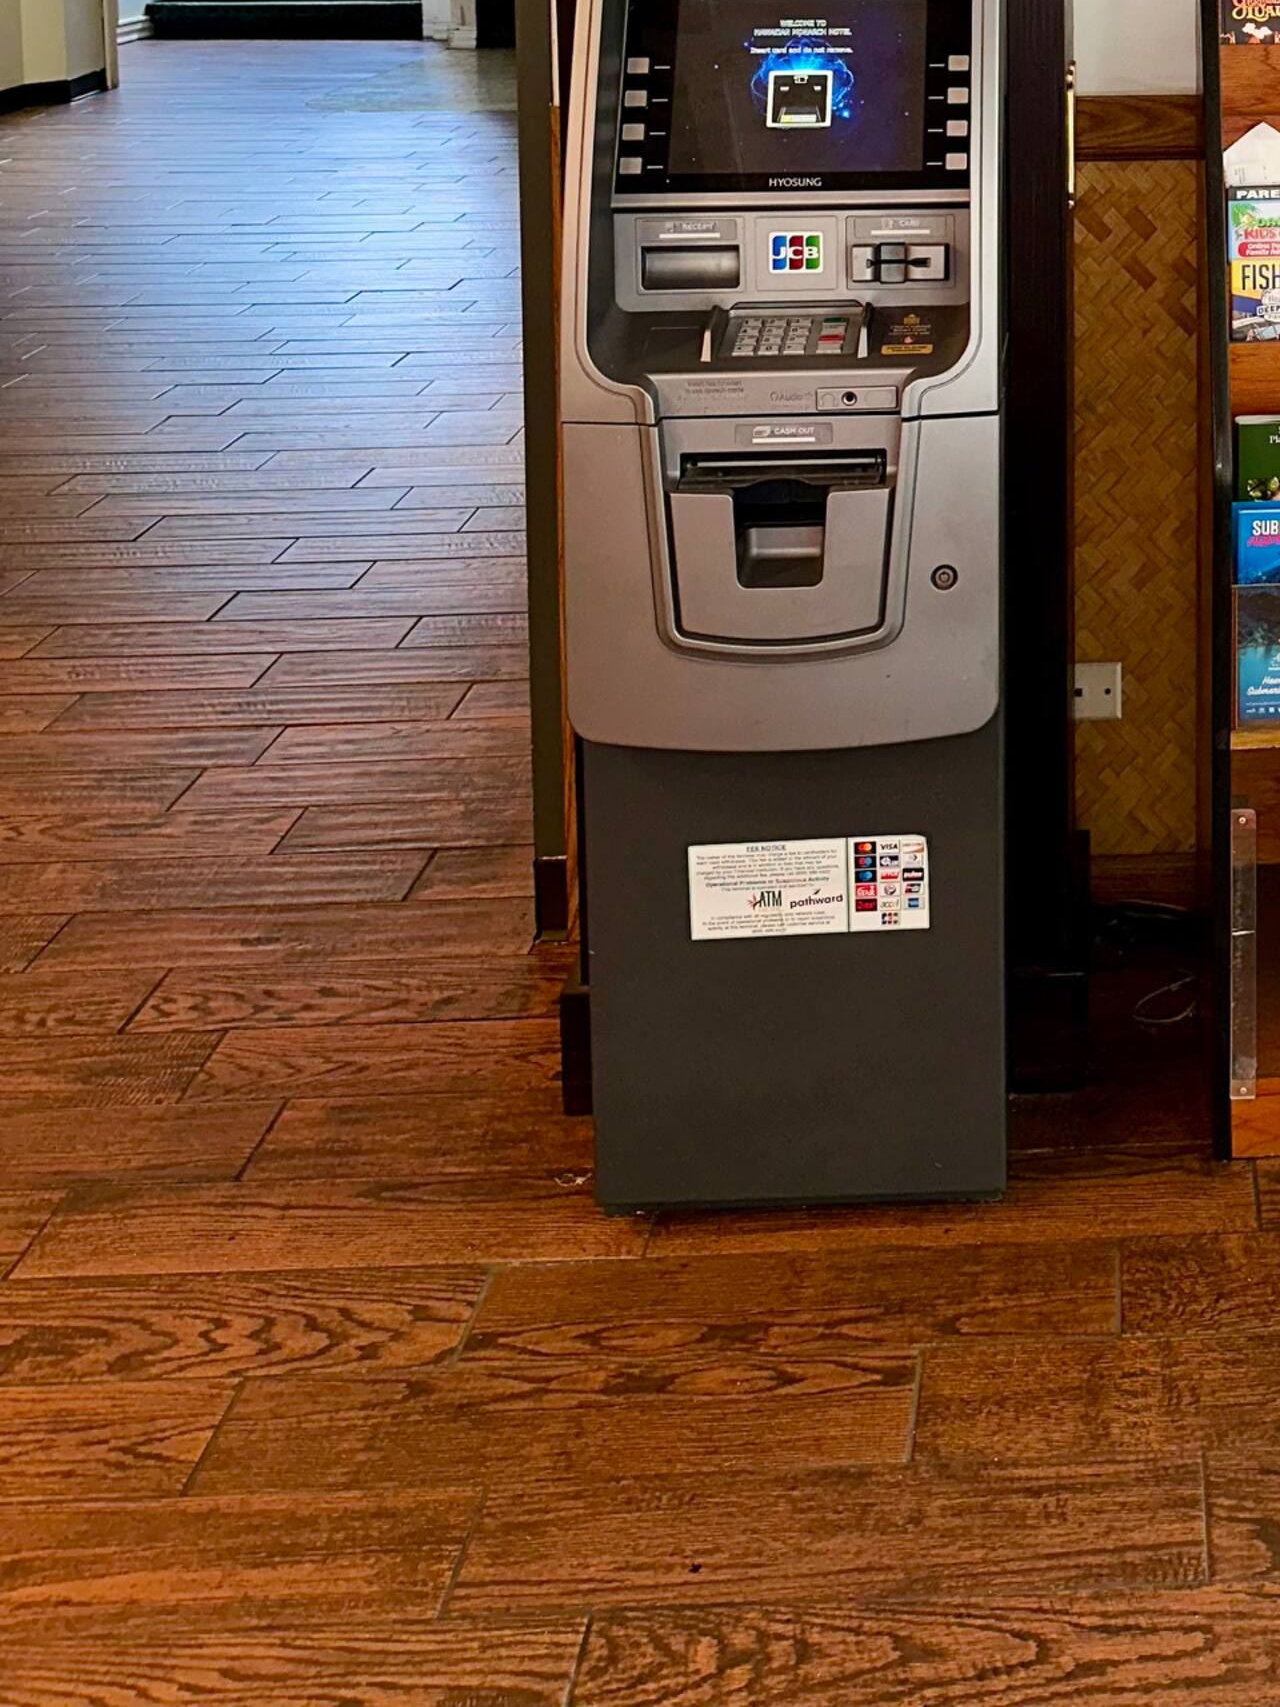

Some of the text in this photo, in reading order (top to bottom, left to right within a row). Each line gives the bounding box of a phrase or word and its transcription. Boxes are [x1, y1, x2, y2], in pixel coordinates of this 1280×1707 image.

[768, 177, 822, 187] HYOSUNG
[770, 246, 819, 259] JCB
[1258, 304, 1280, 315] DEEP
[773, 427, 796, 435] CASH
[758, 890, 783, 908] ATM
[789, 894, 844, 910] pathward
